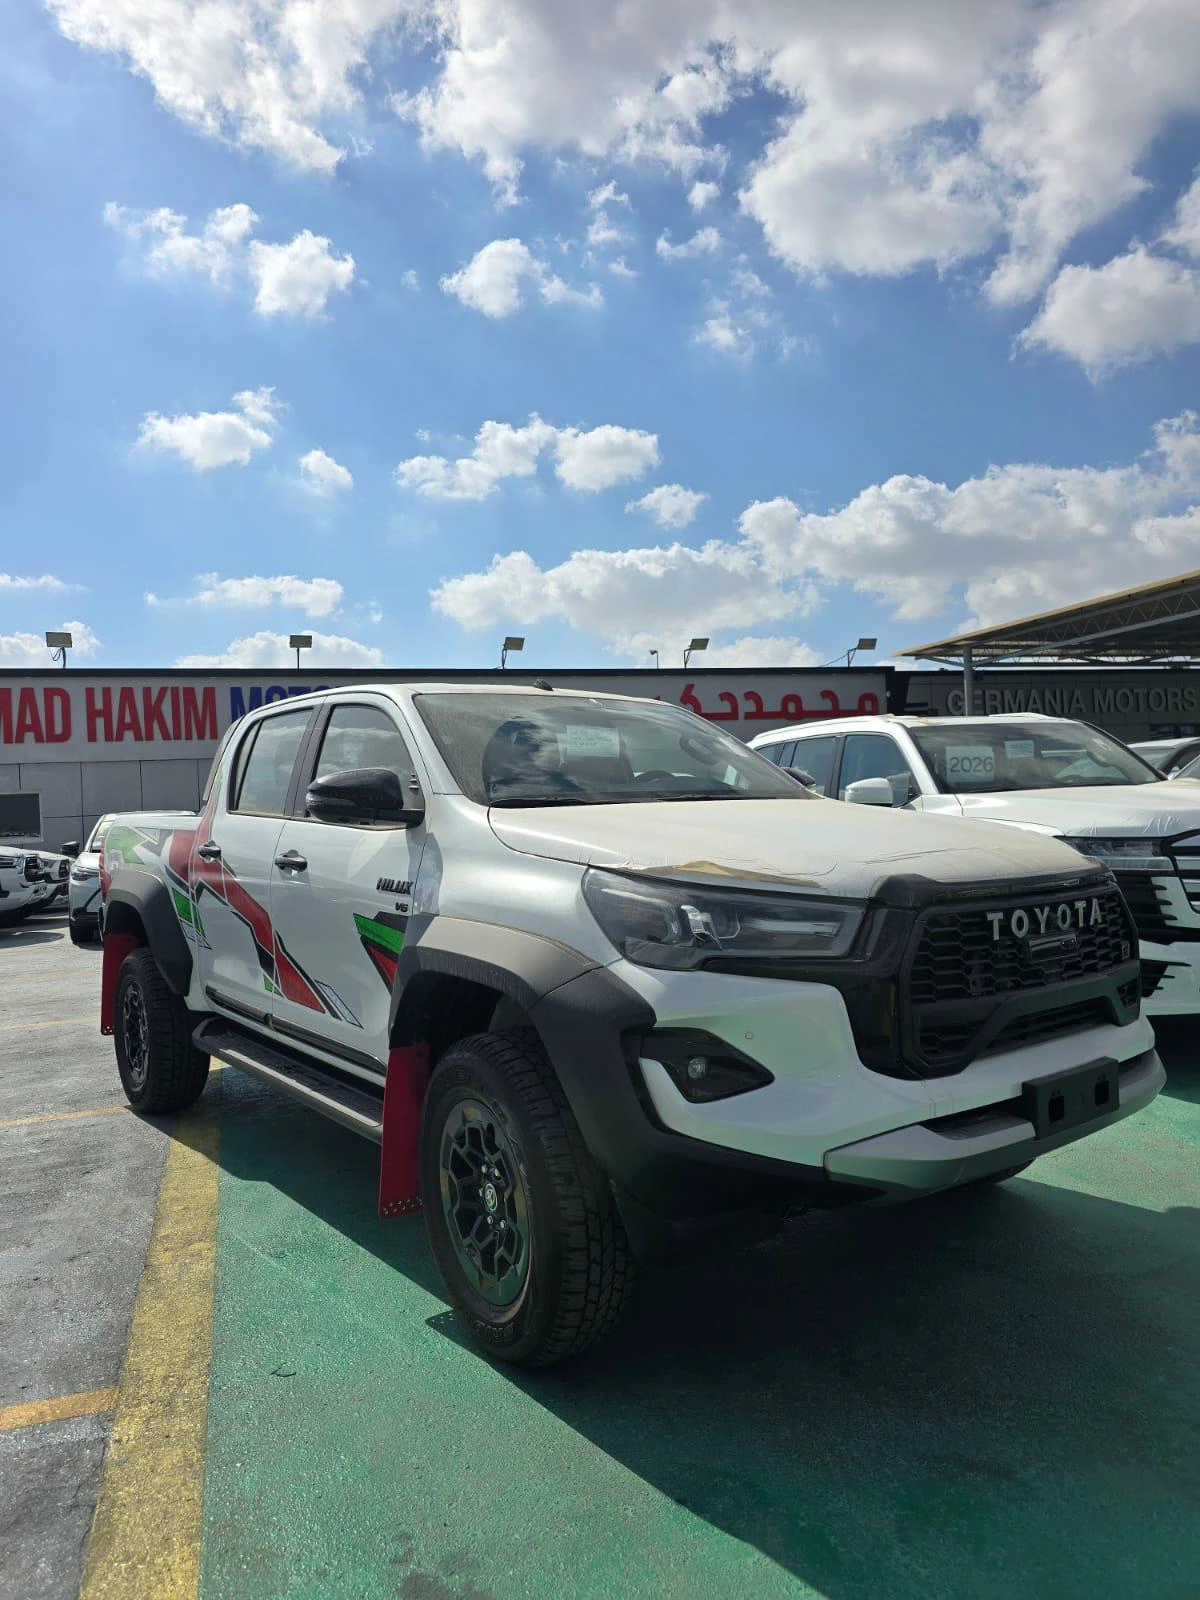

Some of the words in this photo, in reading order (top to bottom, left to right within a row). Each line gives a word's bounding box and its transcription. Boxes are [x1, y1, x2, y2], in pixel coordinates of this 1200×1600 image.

[85, 686, 218, 742] HAKIM
[744, 689, 879, 720] محمد
[947, 687, 1087, 716] GERMANIA
[1094, 687, 1197, 713] MOTORS
[950, 756, 994, 773] 2026
[376, 877, 414, 895] HILUX
[395, 902, 409, 913] V6
[986, 897, 1103, 941] TOYOTA
